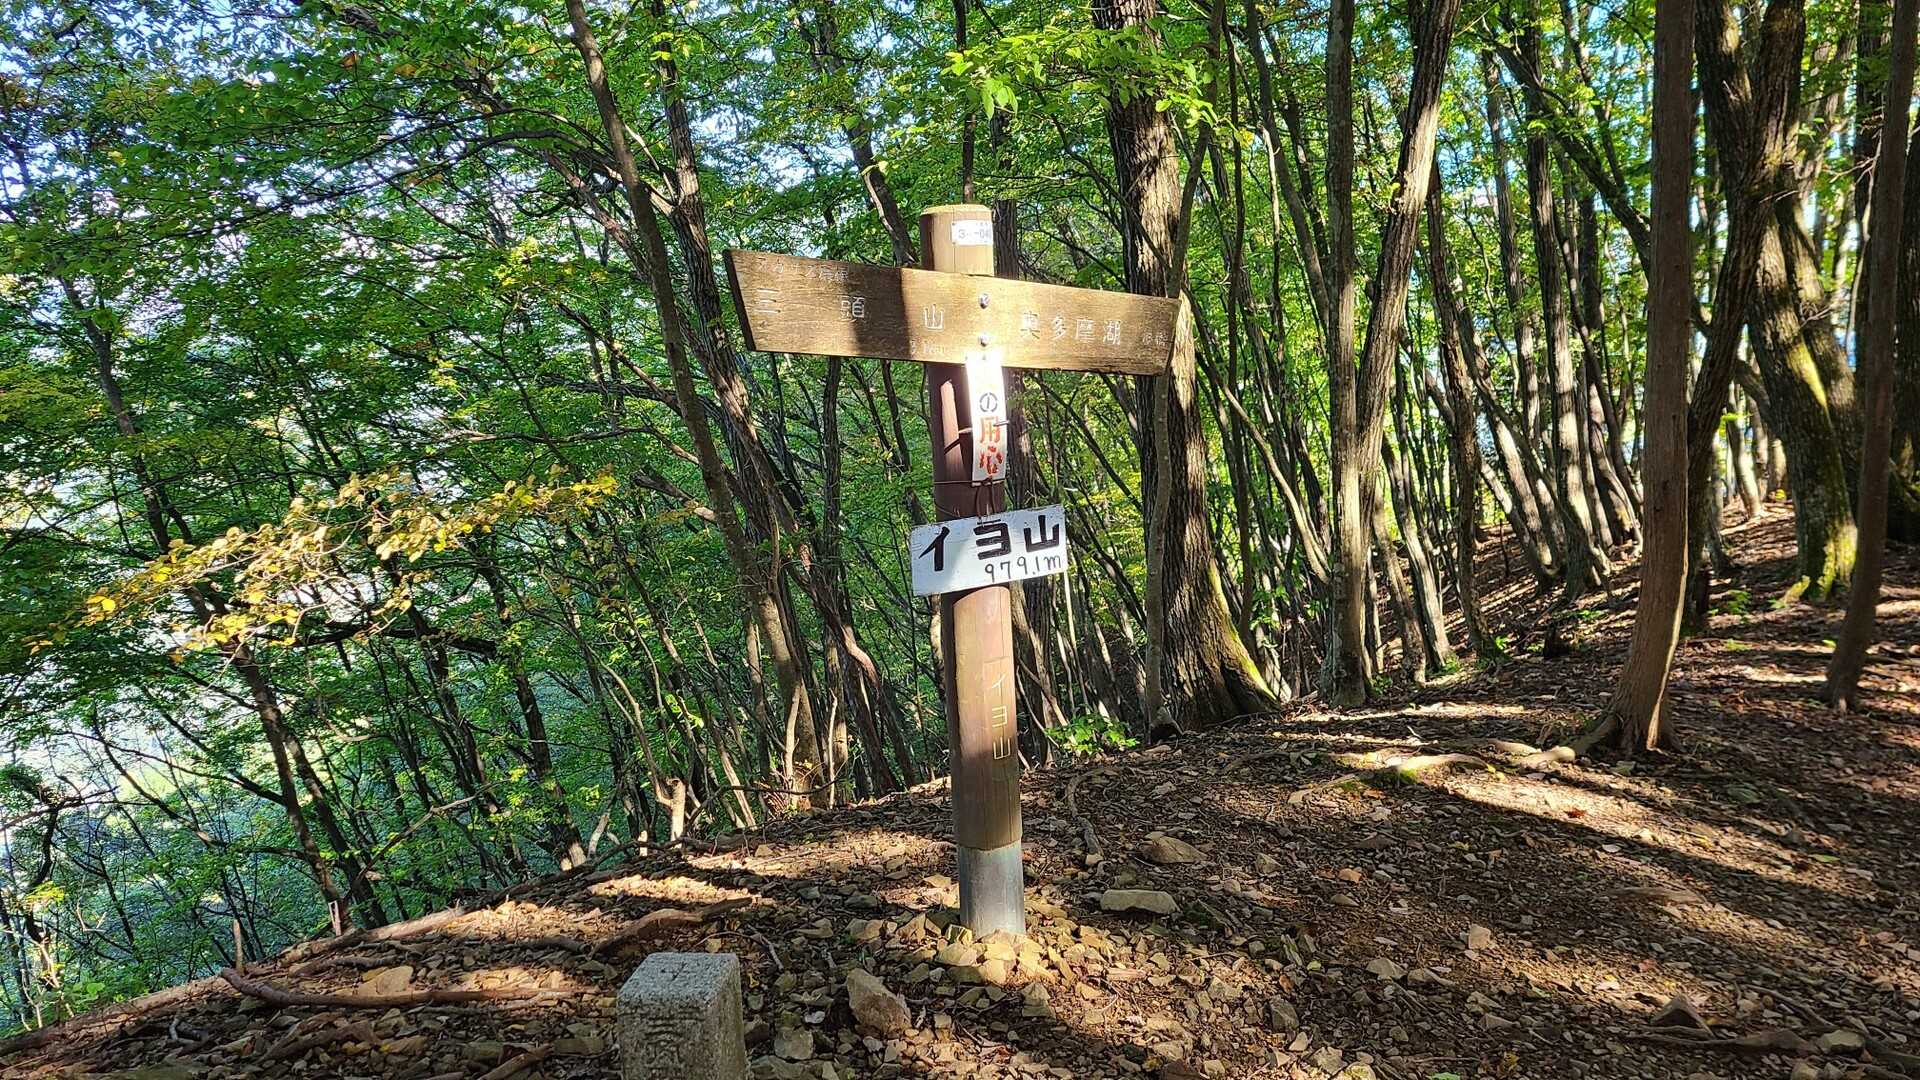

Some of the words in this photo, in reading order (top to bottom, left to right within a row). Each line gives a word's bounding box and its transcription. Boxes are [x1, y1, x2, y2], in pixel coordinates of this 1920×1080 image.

[754, 287, 945, 331] 三頭山
[1020, 310, 1122, 346] 奥多摩湖
[918, 514, 1060, 572] イヨ山
[984, 554, 1062, 583] 979.1m
[991, 672, 1011, 760] イヨ山
